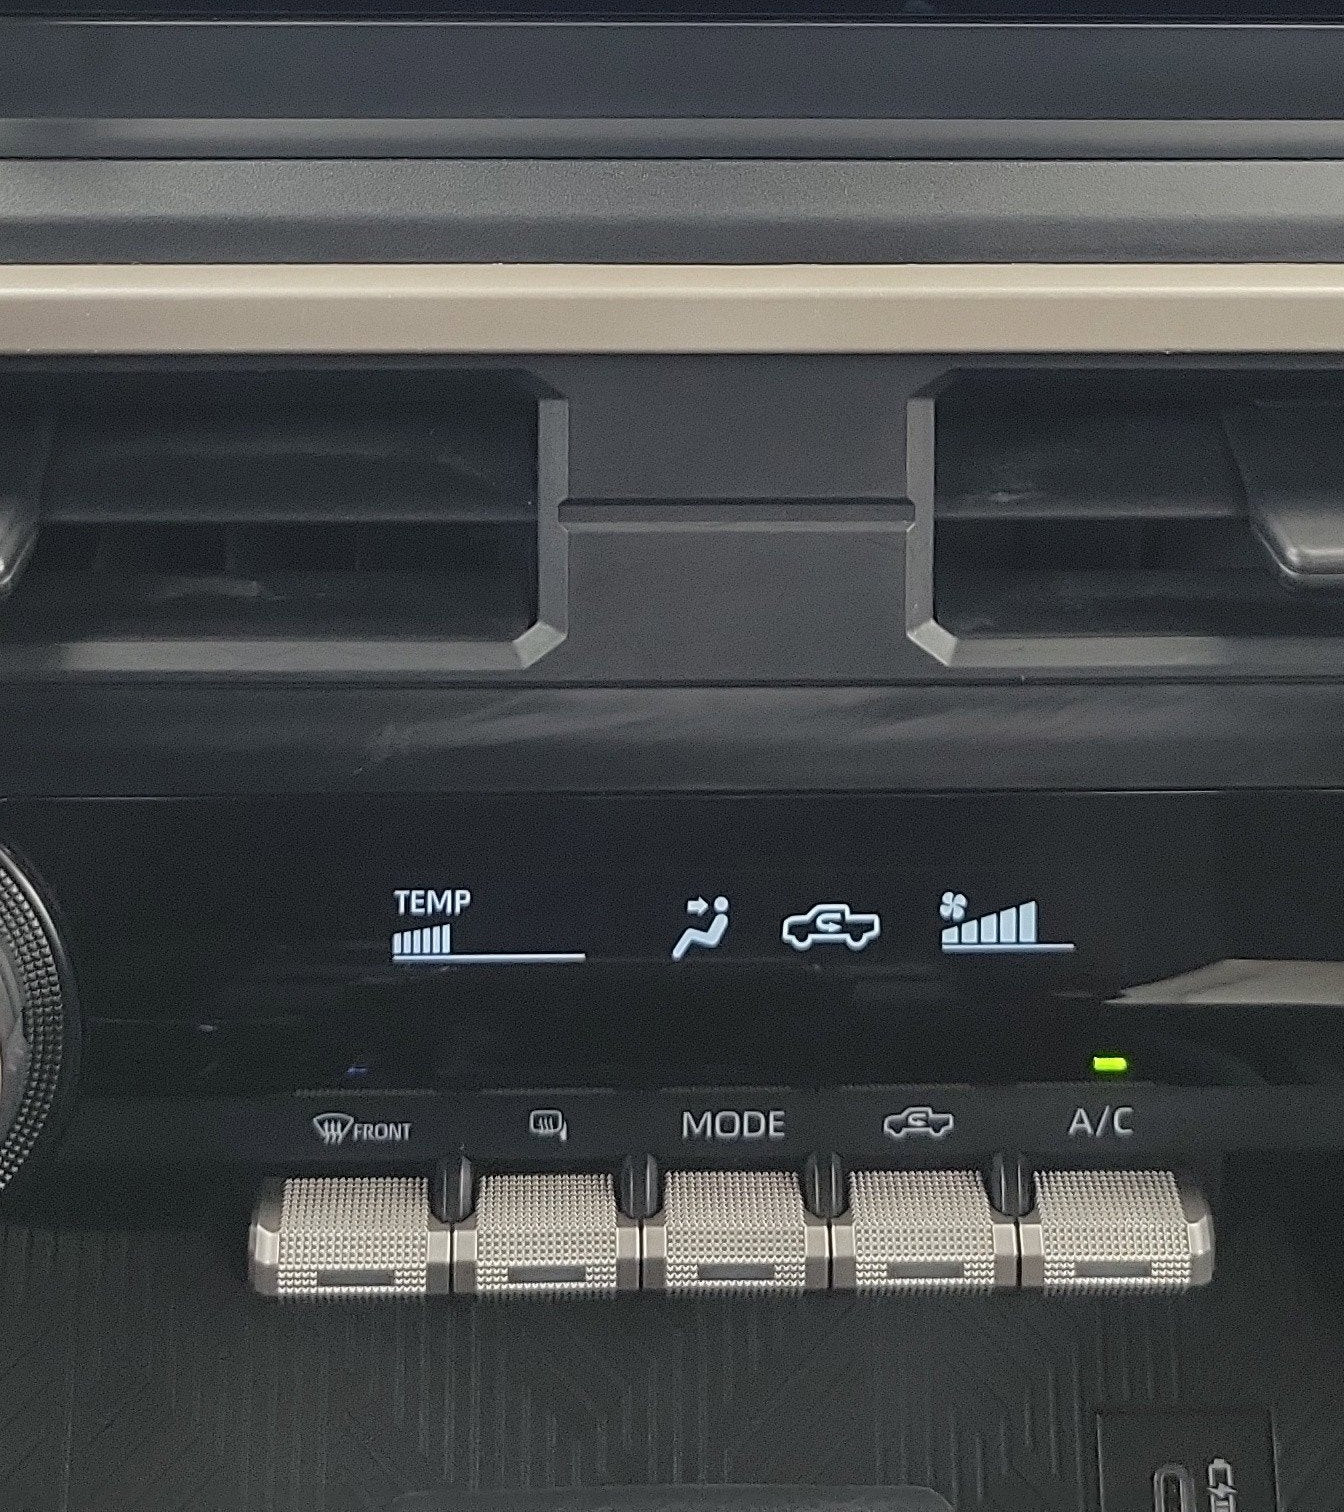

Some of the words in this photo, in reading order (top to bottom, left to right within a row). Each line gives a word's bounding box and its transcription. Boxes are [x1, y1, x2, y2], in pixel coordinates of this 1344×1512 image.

[393, 888, 472, 917] TEMP
[353, 1122, 412, 1141] FRONT
[681, 1109, 786, 1139] MODE
[1067, 1104, 1134, 1138] A/C
